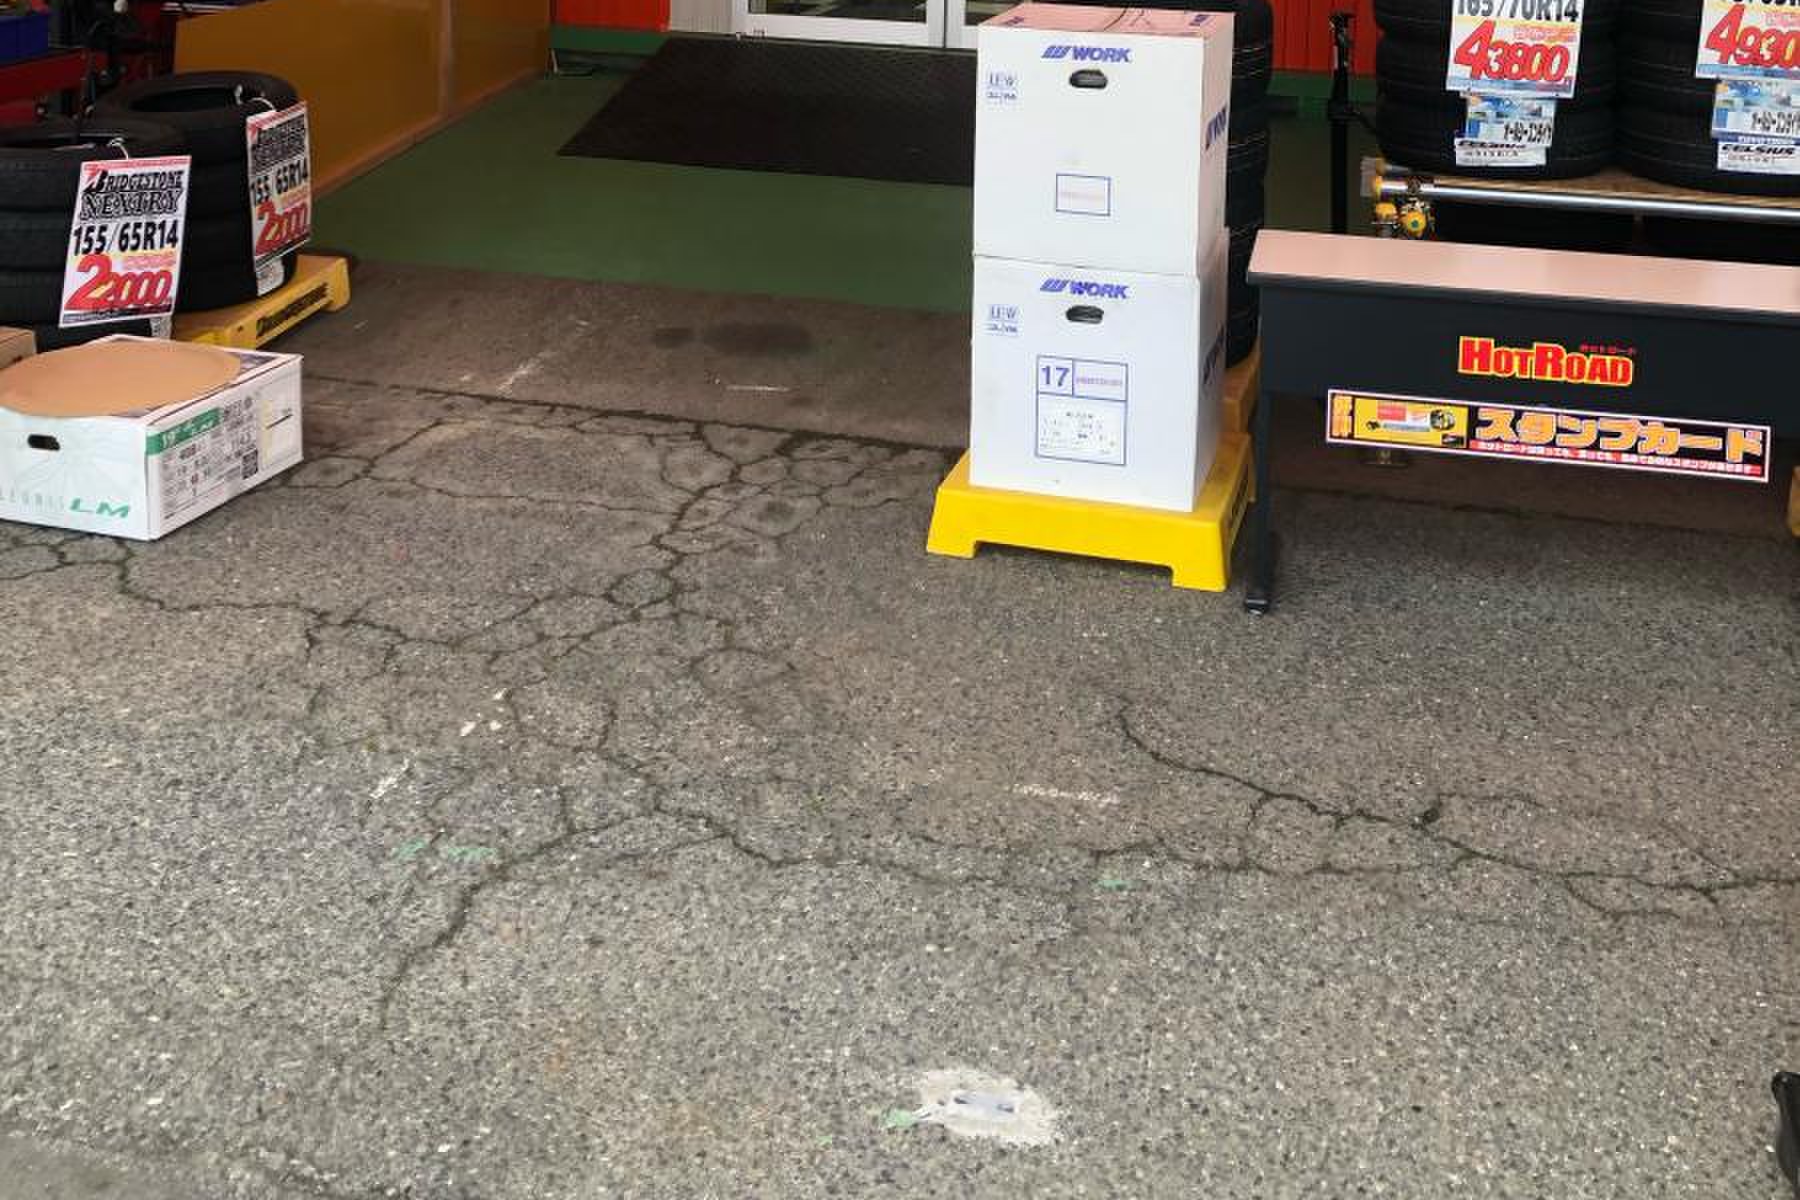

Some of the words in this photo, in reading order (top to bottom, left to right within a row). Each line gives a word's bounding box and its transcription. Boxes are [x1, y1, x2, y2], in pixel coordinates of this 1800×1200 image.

[1454, 19, 1569, 81] 43800
[97, 169, 184, 192] BRIDGESTONE
[73, 220, 179, 256] 155/65R14
[1041, 365, 1071, 387] 17
[1475, 406, 1763, 465] スタンプカード
[70, 498, 130, 518] LM
